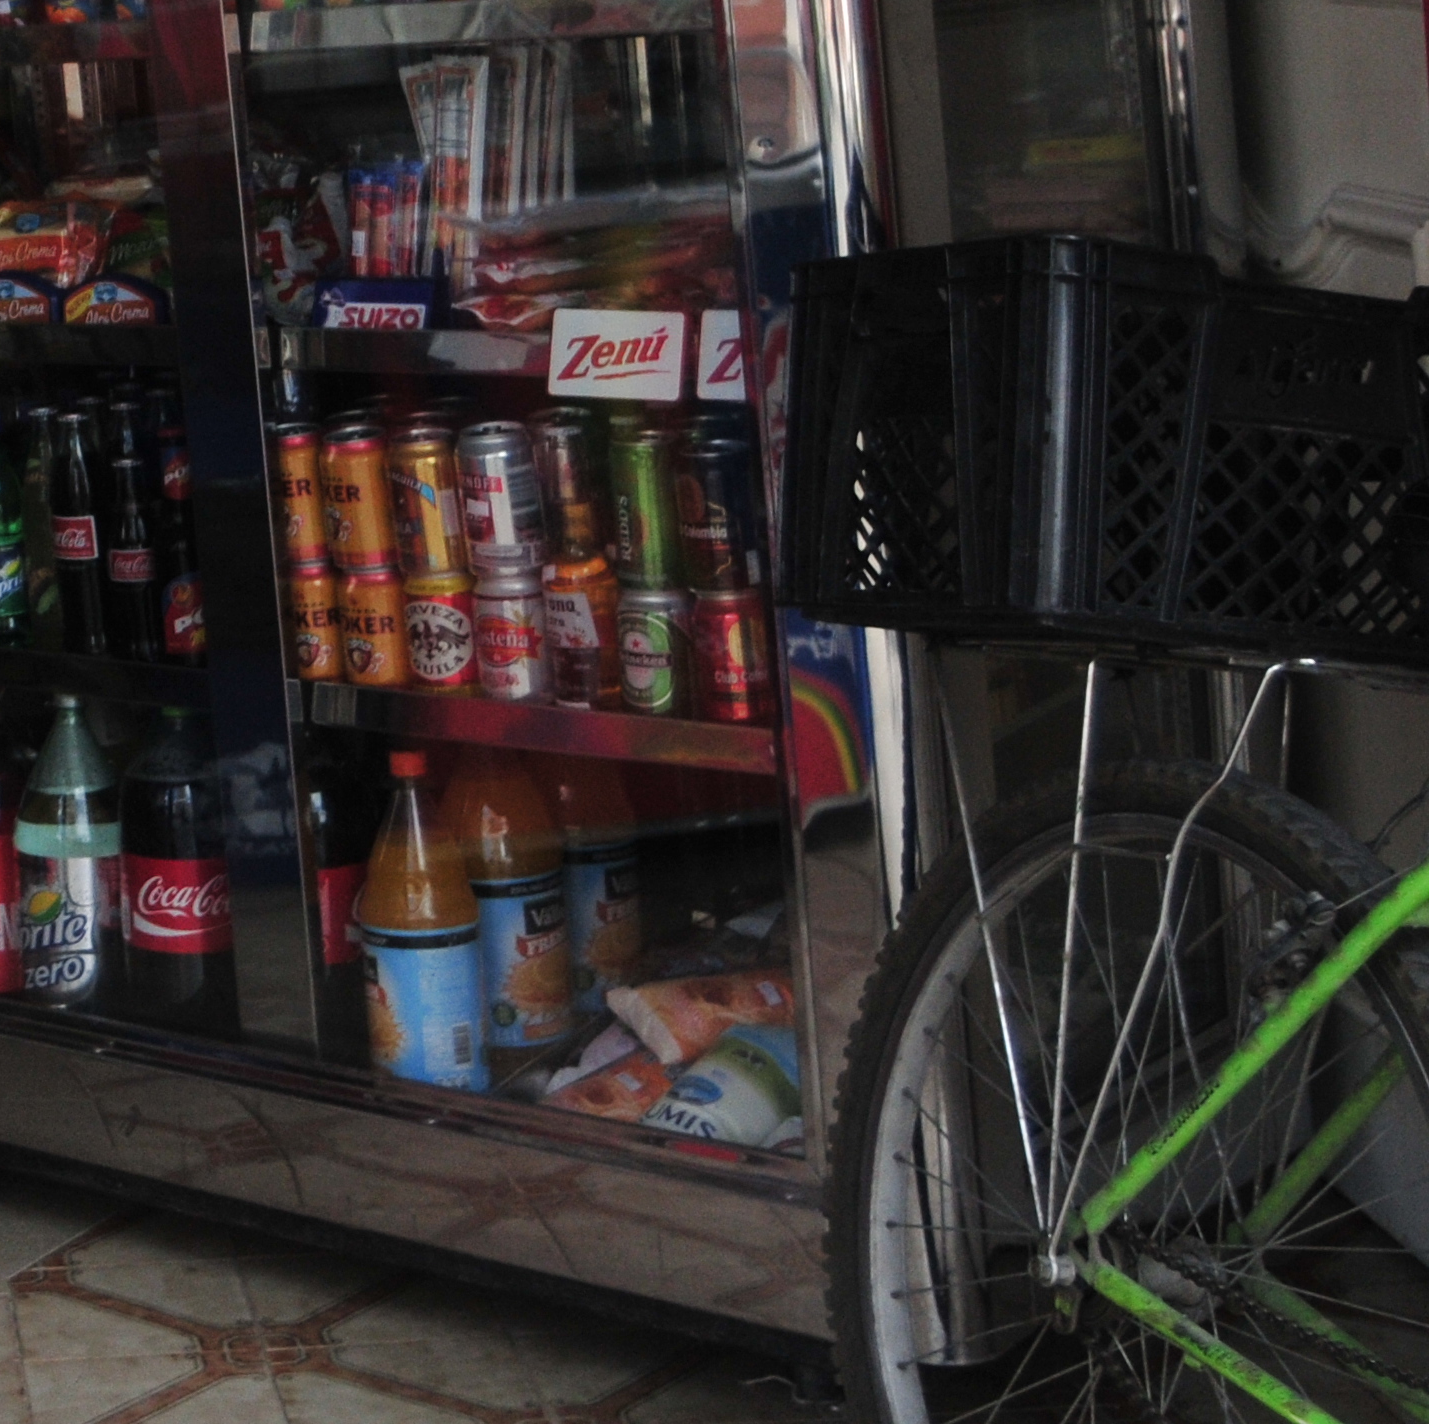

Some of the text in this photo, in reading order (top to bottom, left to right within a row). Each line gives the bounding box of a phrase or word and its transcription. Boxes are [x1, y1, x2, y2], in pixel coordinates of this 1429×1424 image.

[556, 326, 670, 382] Zenú
[479, 630, 530, 648] osteña
[24, 953, 85, 990] zero
[646, 1102, 717, 1139] UMIS
